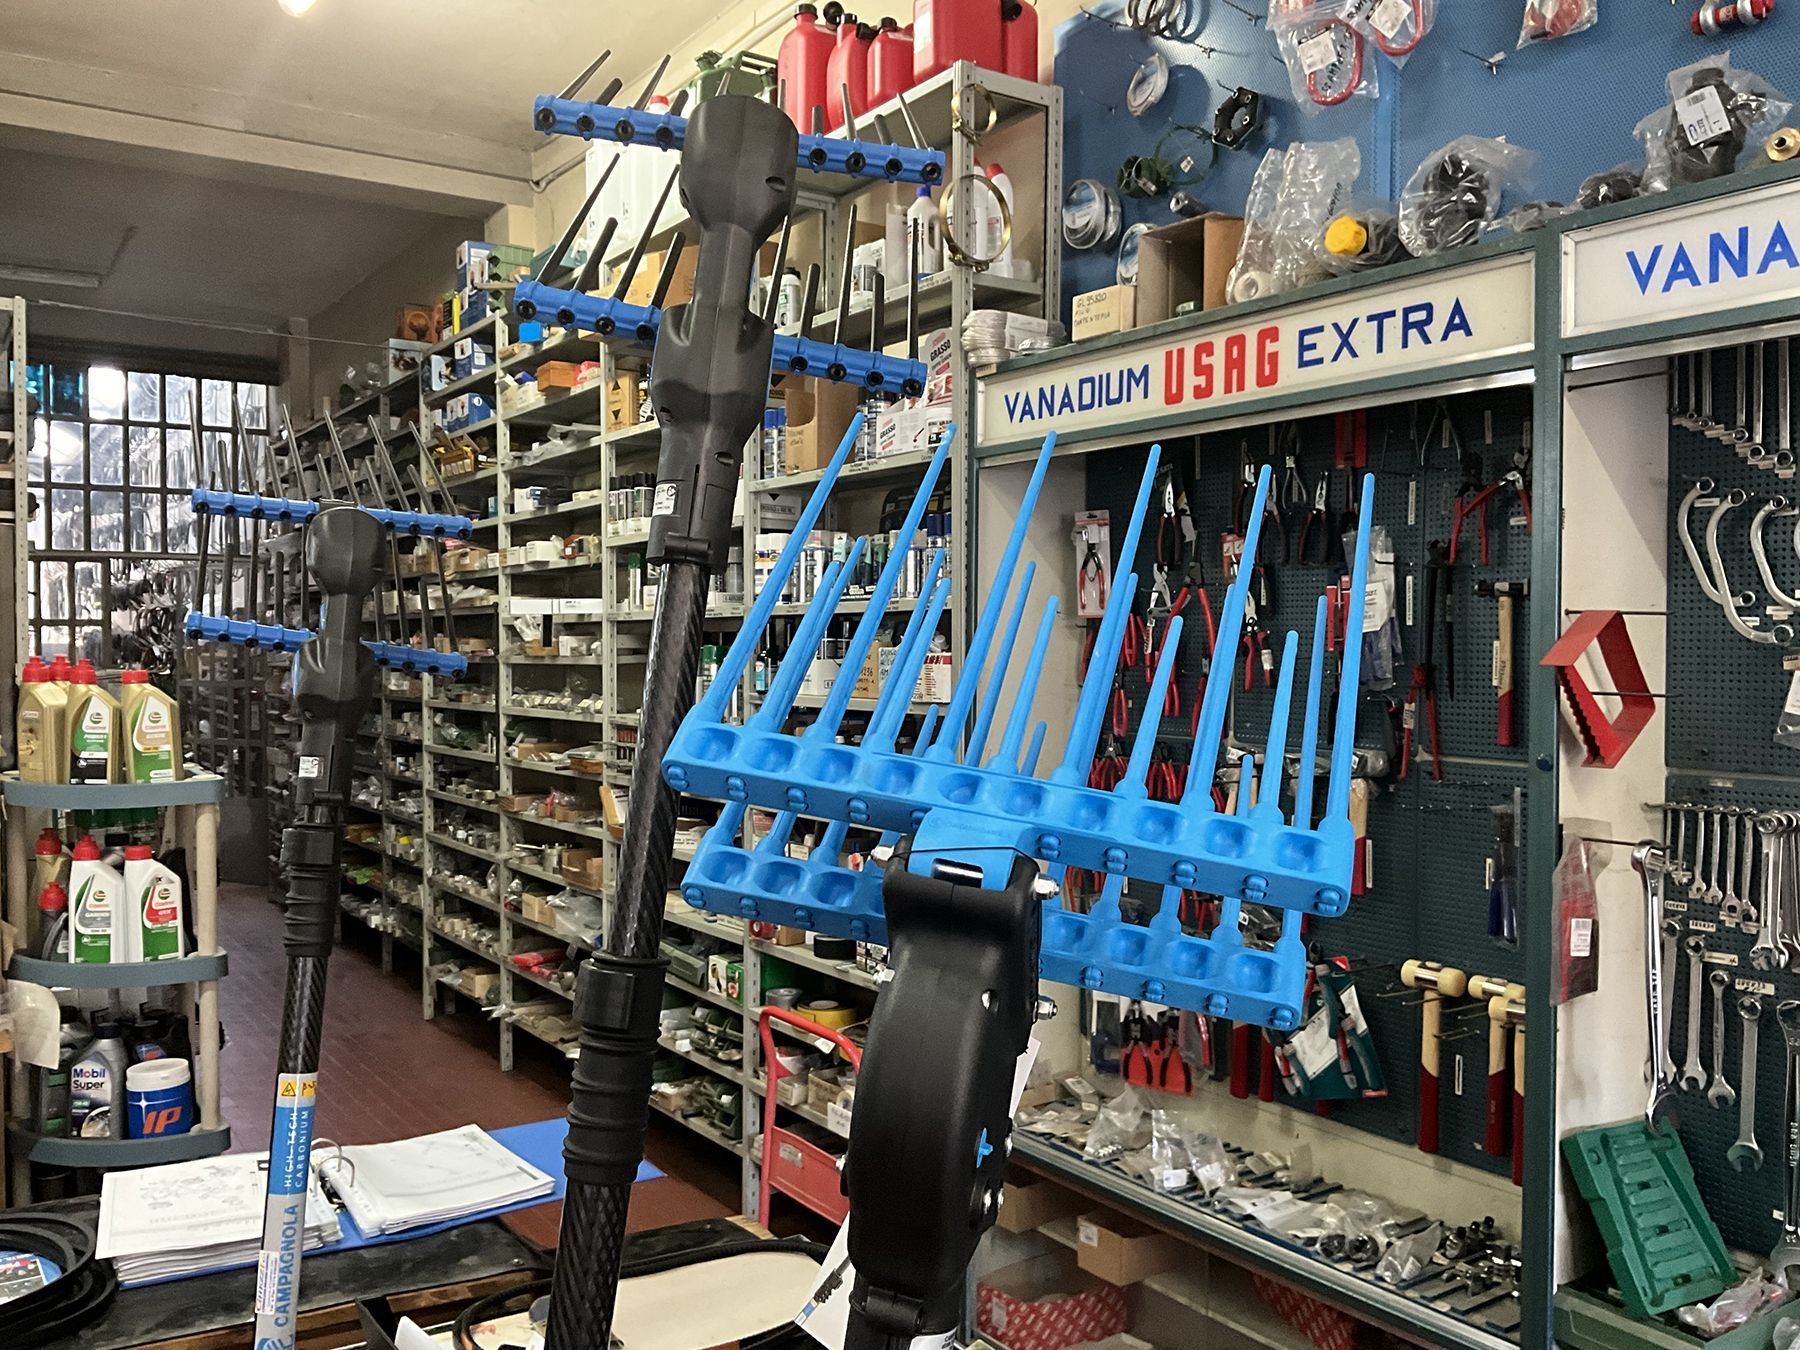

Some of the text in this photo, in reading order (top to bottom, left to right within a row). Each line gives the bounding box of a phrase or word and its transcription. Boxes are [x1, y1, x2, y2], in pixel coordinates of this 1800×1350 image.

[1625, 219, 1800, 296] VANA
[929, 339, 951, 362] GRASSO
[1005, 296, 1473, 424] VANADIUM USAG EXTRA
[880, 423, 896, 439] GRASSO
[73, 1068, 106, 1079] Mobil
[73, 1080, 105, 1091] Super
[144, 1107, 182, 1134] IP
[295, 1110, 309, 1188] CARBONIUM
[274, 1204, 299, 1328] CAMPAGNOLA
